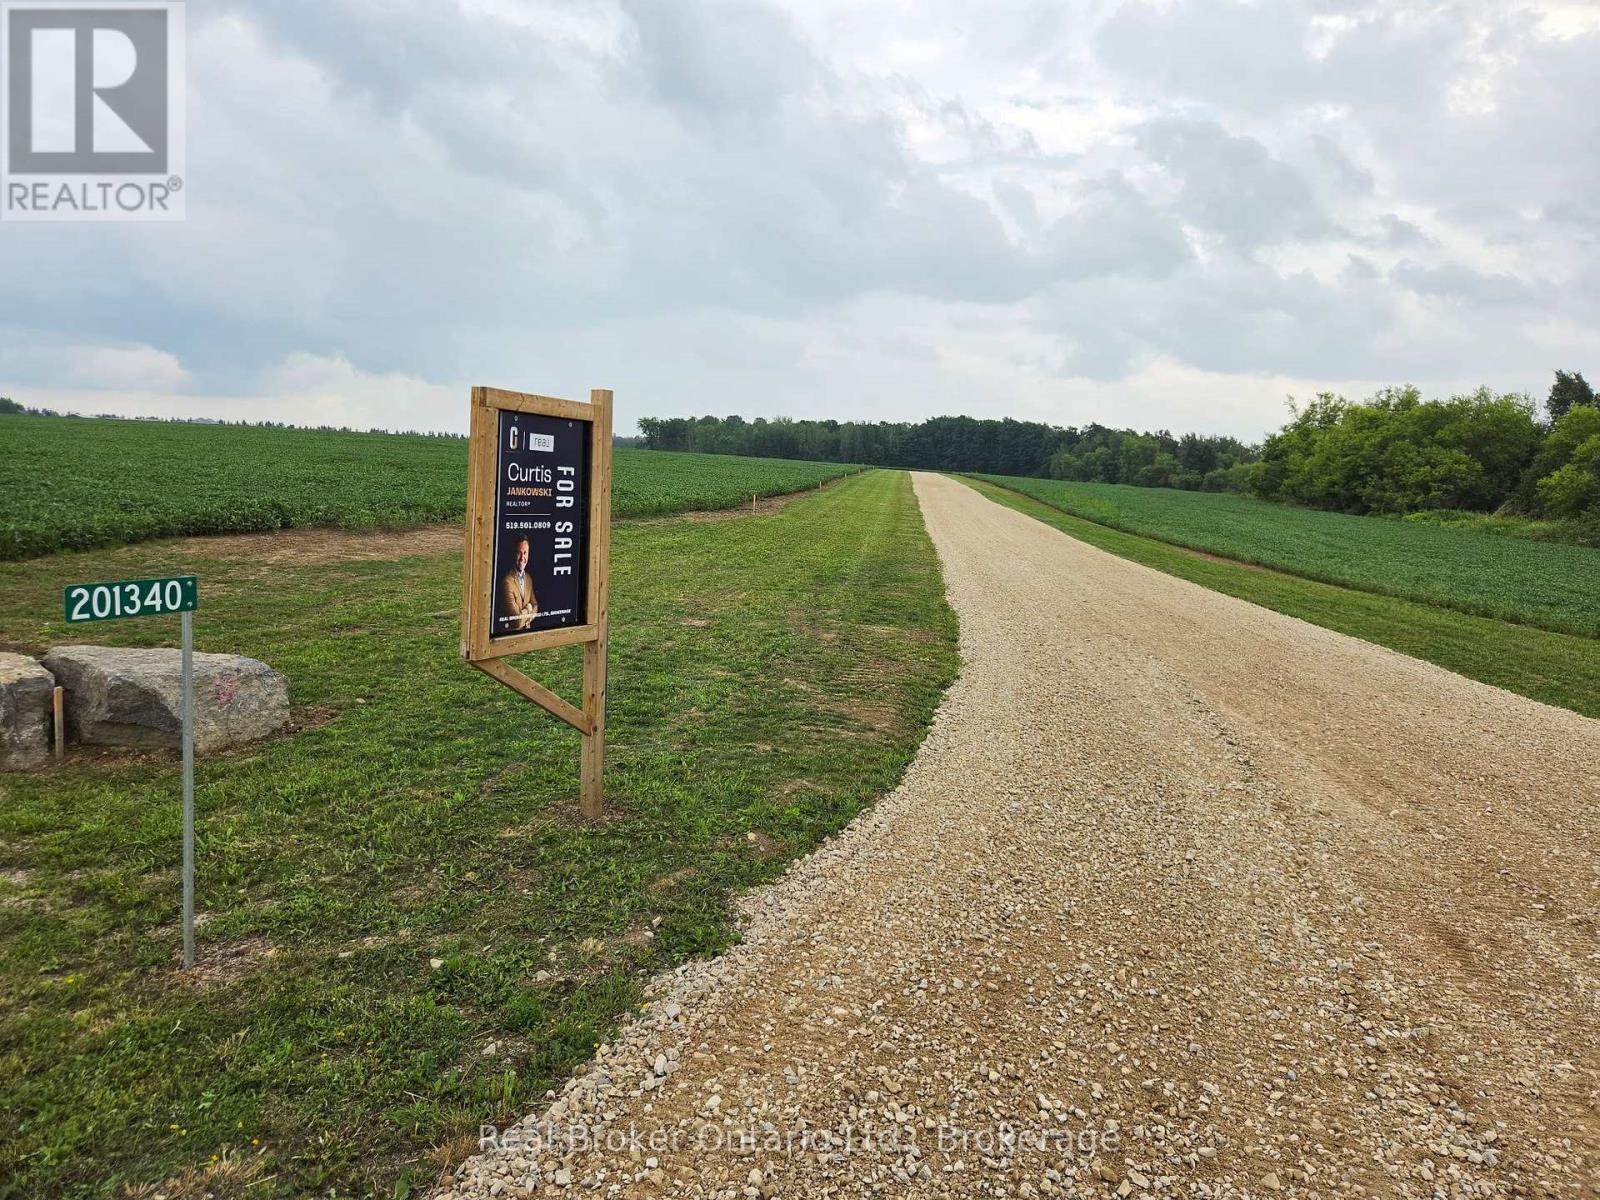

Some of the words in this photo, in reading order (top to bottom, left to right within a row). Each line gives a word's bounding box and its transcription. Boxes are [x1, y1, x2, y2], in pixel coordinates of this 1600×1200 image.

[506, 487, 552, 497] JANKOWSKI
[507, 462, 552, 483] Curtis
[555, 466, 575, 508] FOR
[553, 521, 574, 576] SALE
[71, 580, 182, 621] 201340
